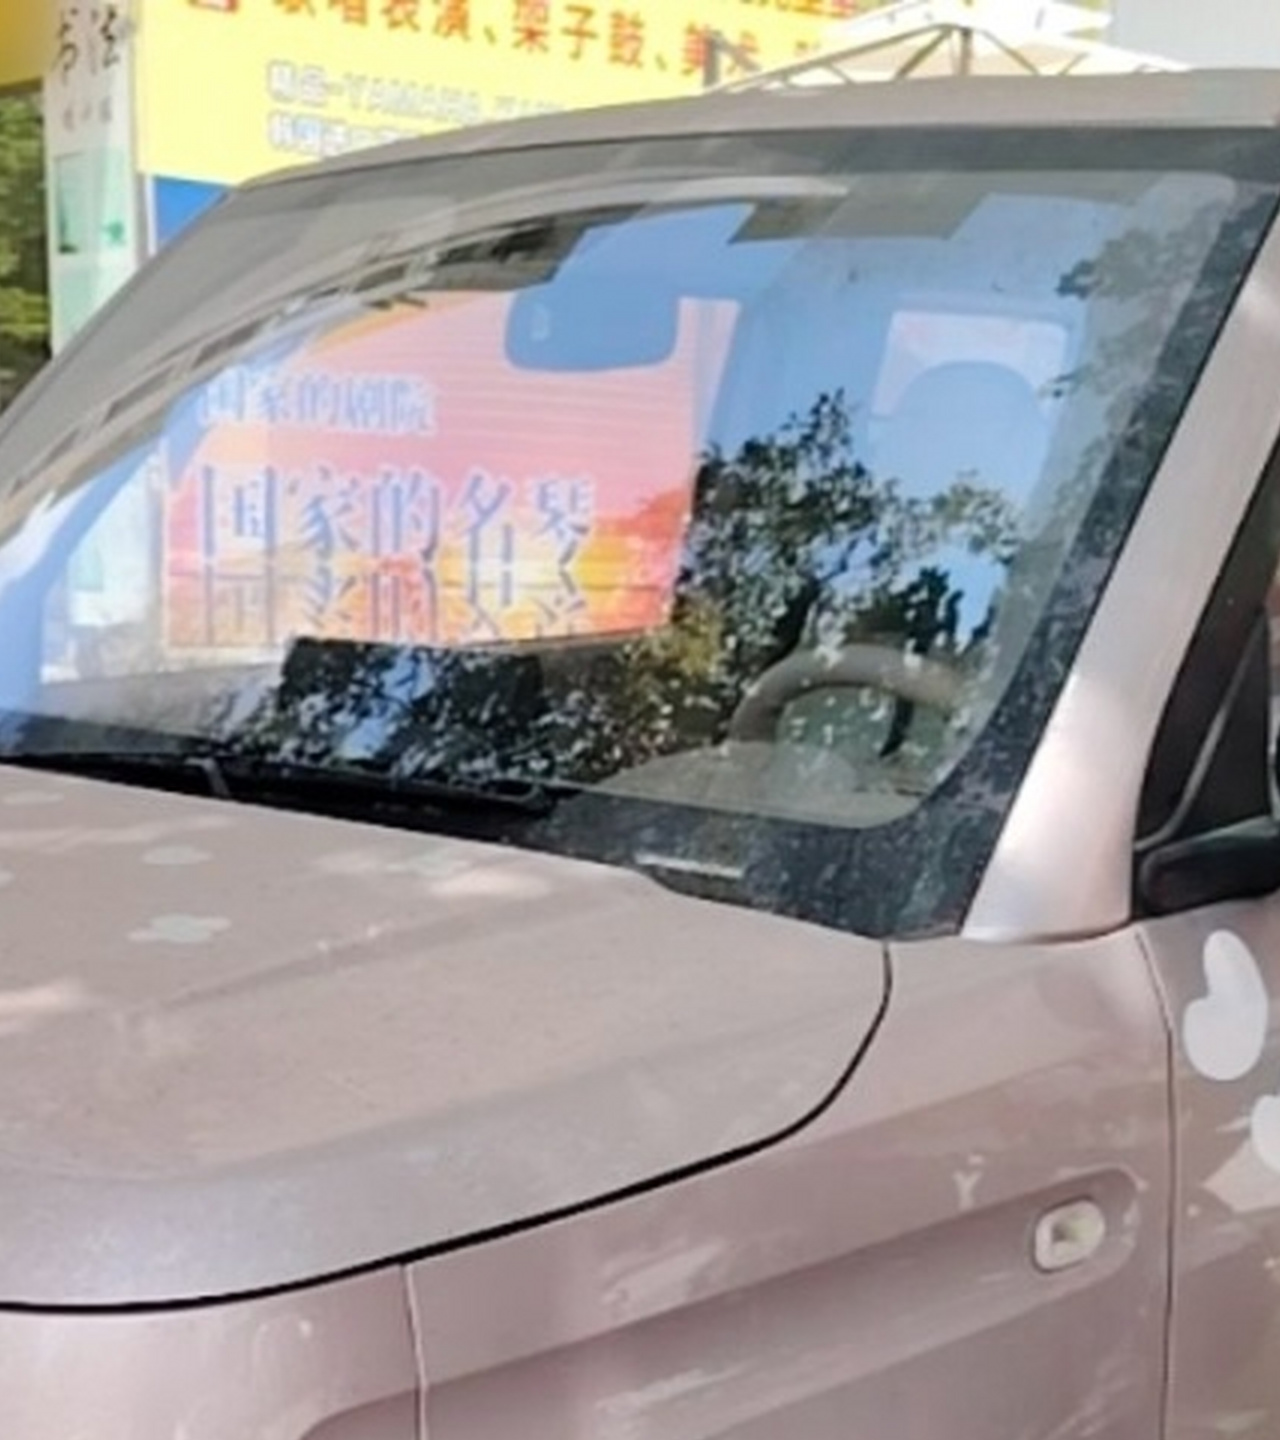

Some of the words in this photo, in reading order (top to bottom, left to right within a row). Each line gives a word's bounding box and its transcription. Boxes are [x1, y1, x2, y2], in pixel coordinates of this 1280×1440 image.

[200, 462, 595, 567] 国家的名琴
